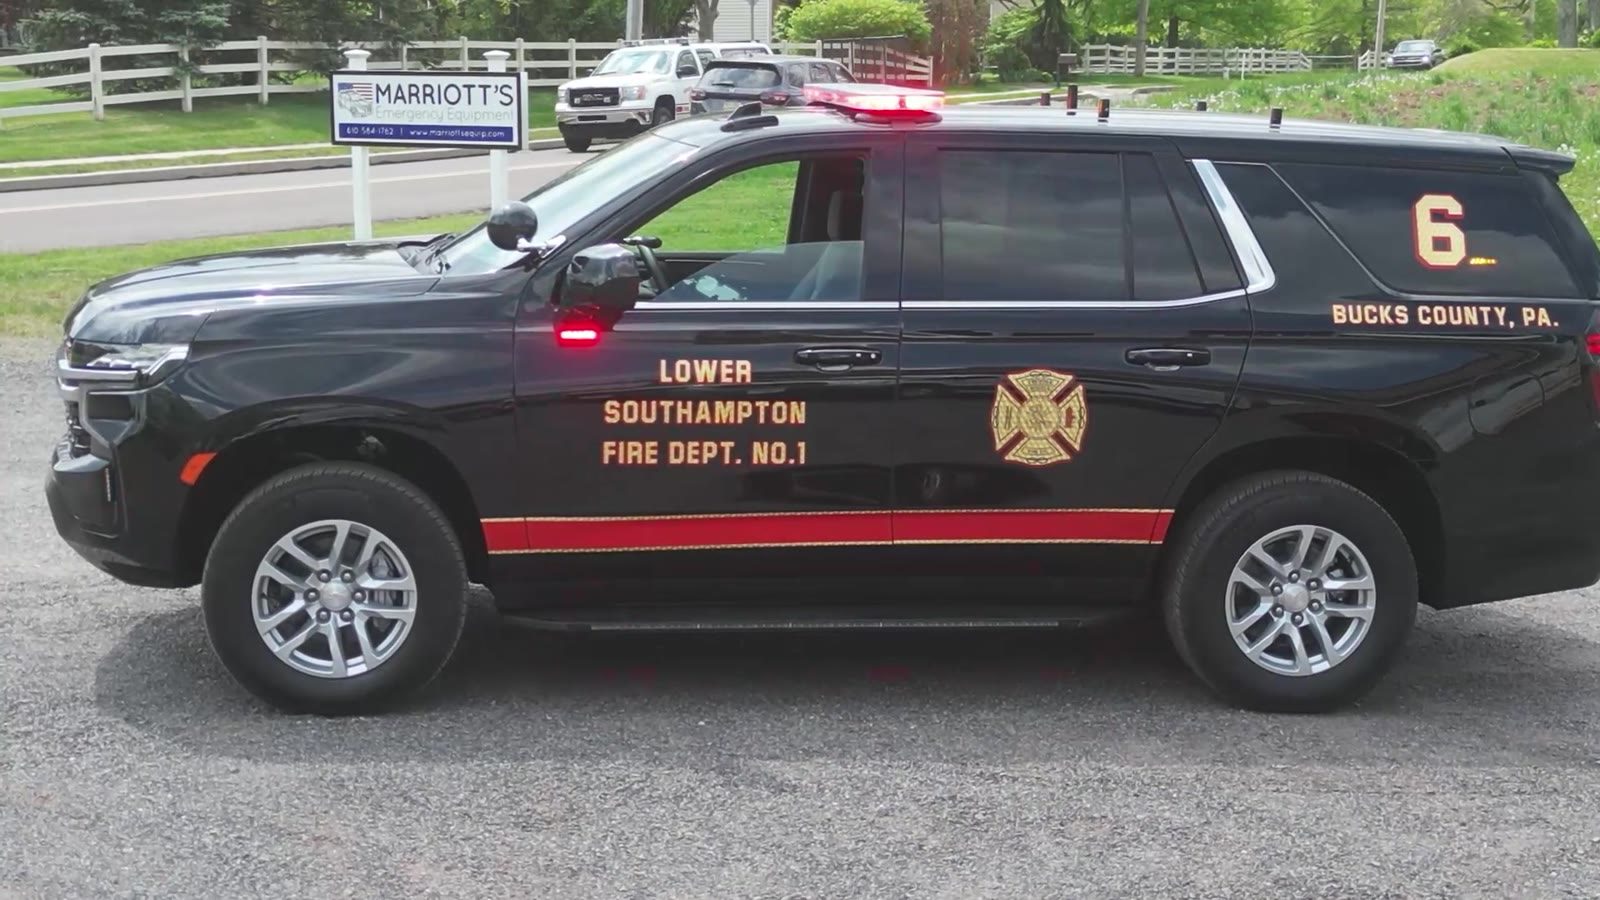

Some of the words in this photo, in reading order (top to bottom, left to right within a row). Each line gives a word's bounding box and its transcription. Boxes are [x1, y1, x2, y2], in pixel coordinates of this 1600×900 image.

[375, 83, 514, 106] MARRIOTT'S
[375, 106, 444, 122] Emergency
[447, 107, 513, 123] Equipment
[1413, 193, 1467, 269] 6
[1332, 304, 1410, 326] BUCKS
[1417, 305, 1516, 329] COUNTY,
[1522, 307, 1560, 328] PA.
[659, 359, 752, 384] LOWER
[604, 400, 806, 425] SOUTHAMPTON
[603, 441, 659, 465] FIRE
[668, 441, 743, 465] DEPT.
